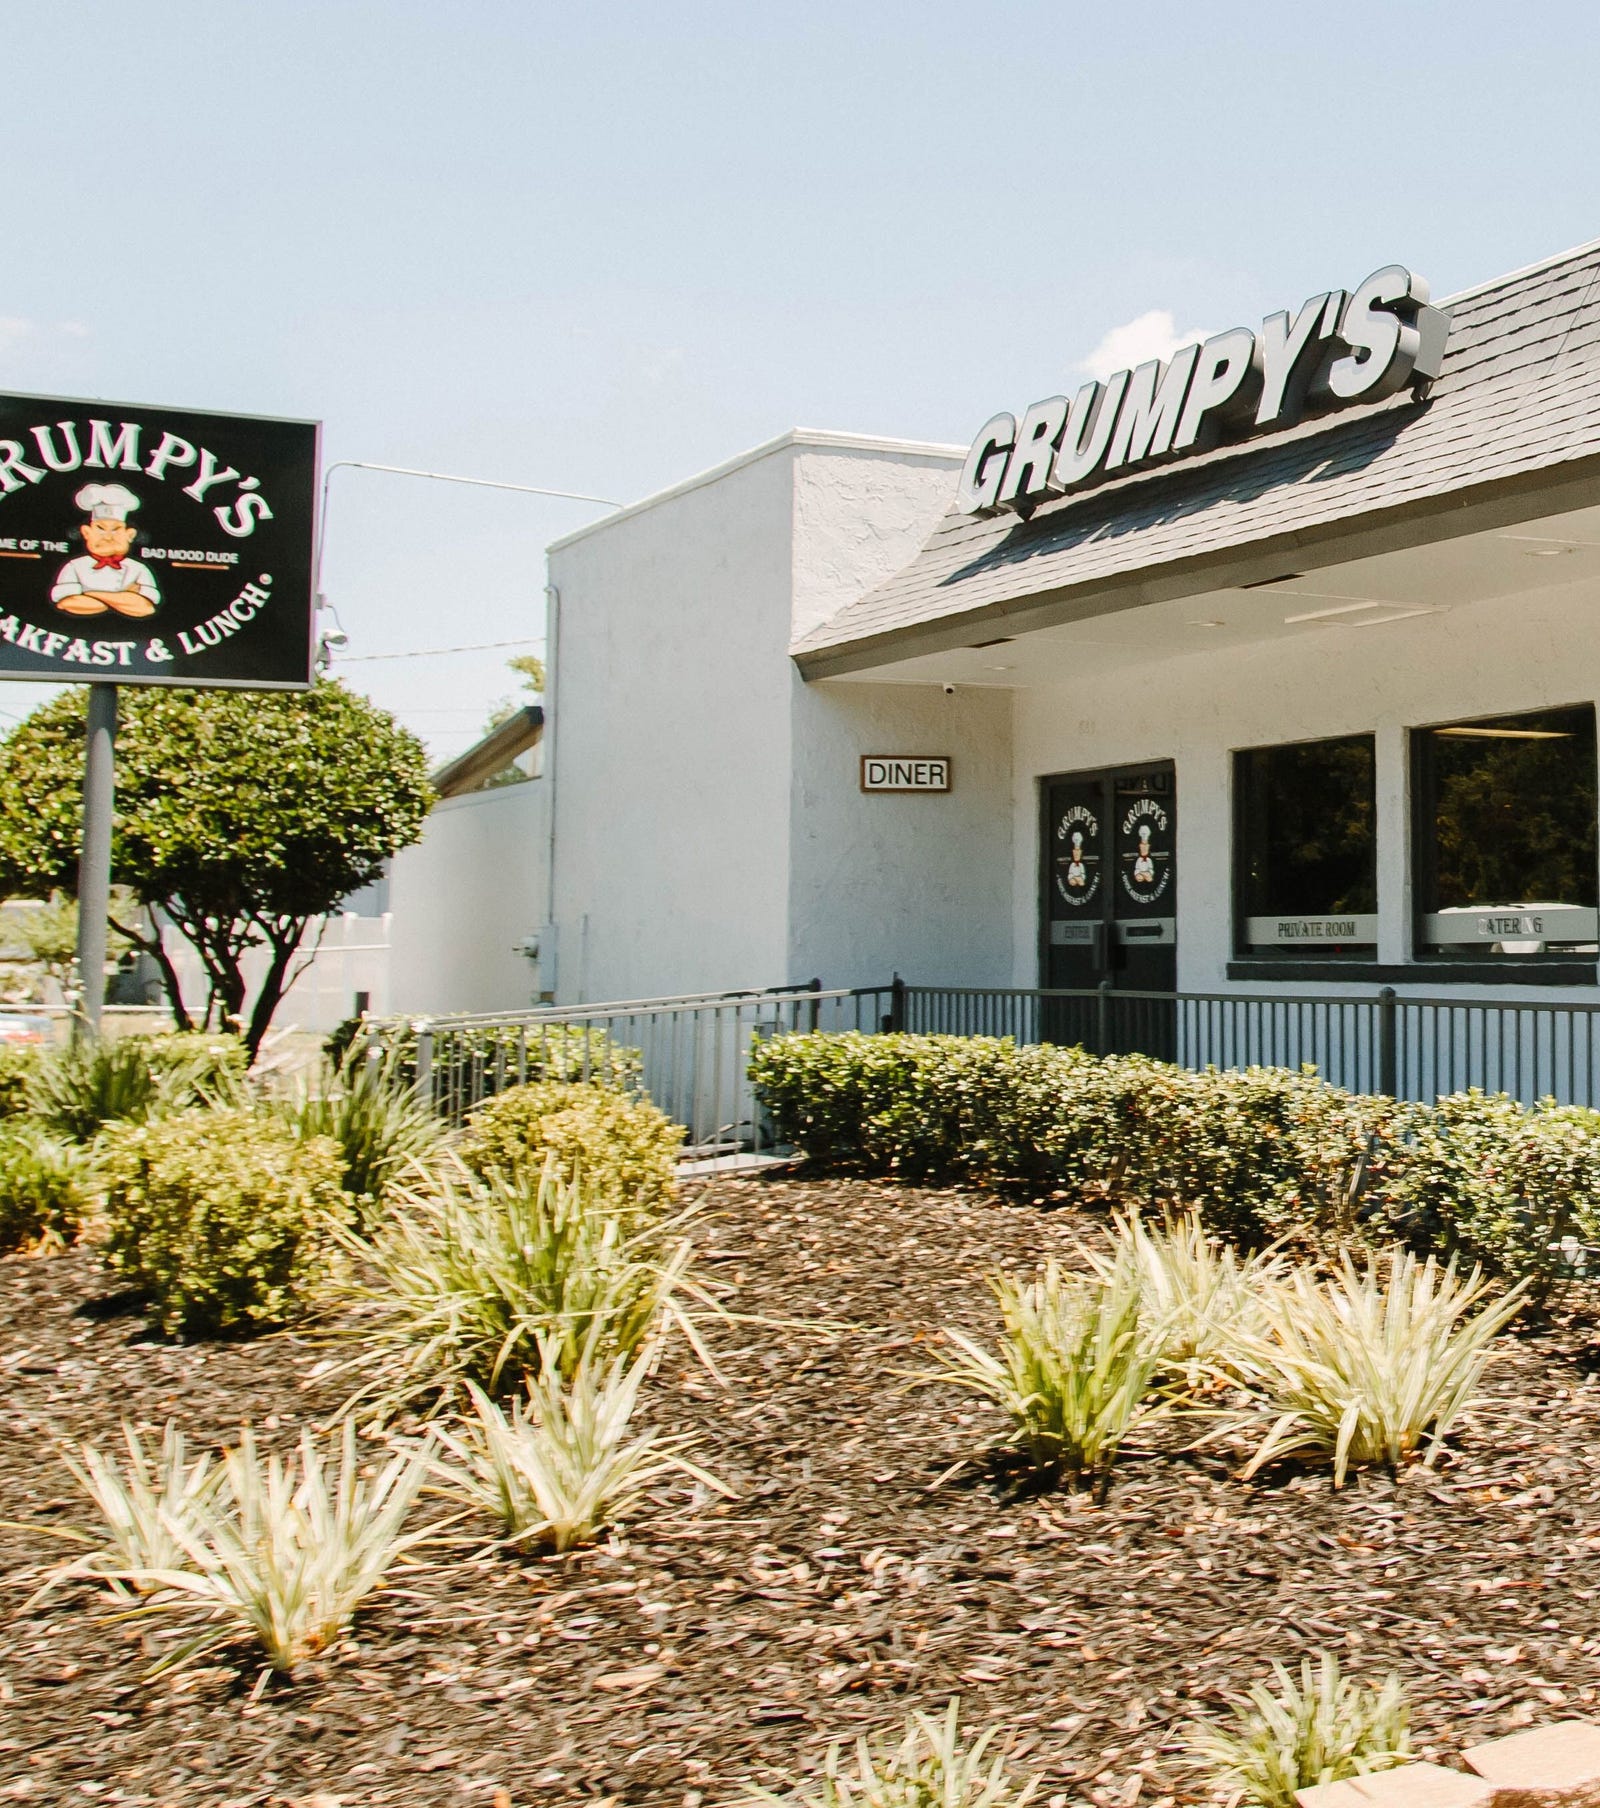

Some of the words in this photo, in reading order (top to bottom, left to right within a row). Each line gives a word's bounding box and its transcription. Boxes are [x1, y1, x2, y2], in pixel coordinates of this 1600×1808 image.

[958, 264, 1420, 515] GRUMPY'S
[0, 419, 274, 537] RUMPY'S
[19, 539, 39, 551] OF
[41, 541, 69, 553] THE
[141, 547, 166, 559] BAD
[168, 549, 205, 561] MOOD
[206, 551, 239, 563] DUDE
[0, 606, 137, 666] AKFAST
[145, 638, 175, 662] &
[177, 582, 272, 655] LUNCH
[868, 763, 945, 786] DINER
[1122, 799, 1167, 834] GRUMPY'S
[1278, 921, 1322, 937] PRIVATE
[1325, 921, 1355, 937] ROOM
